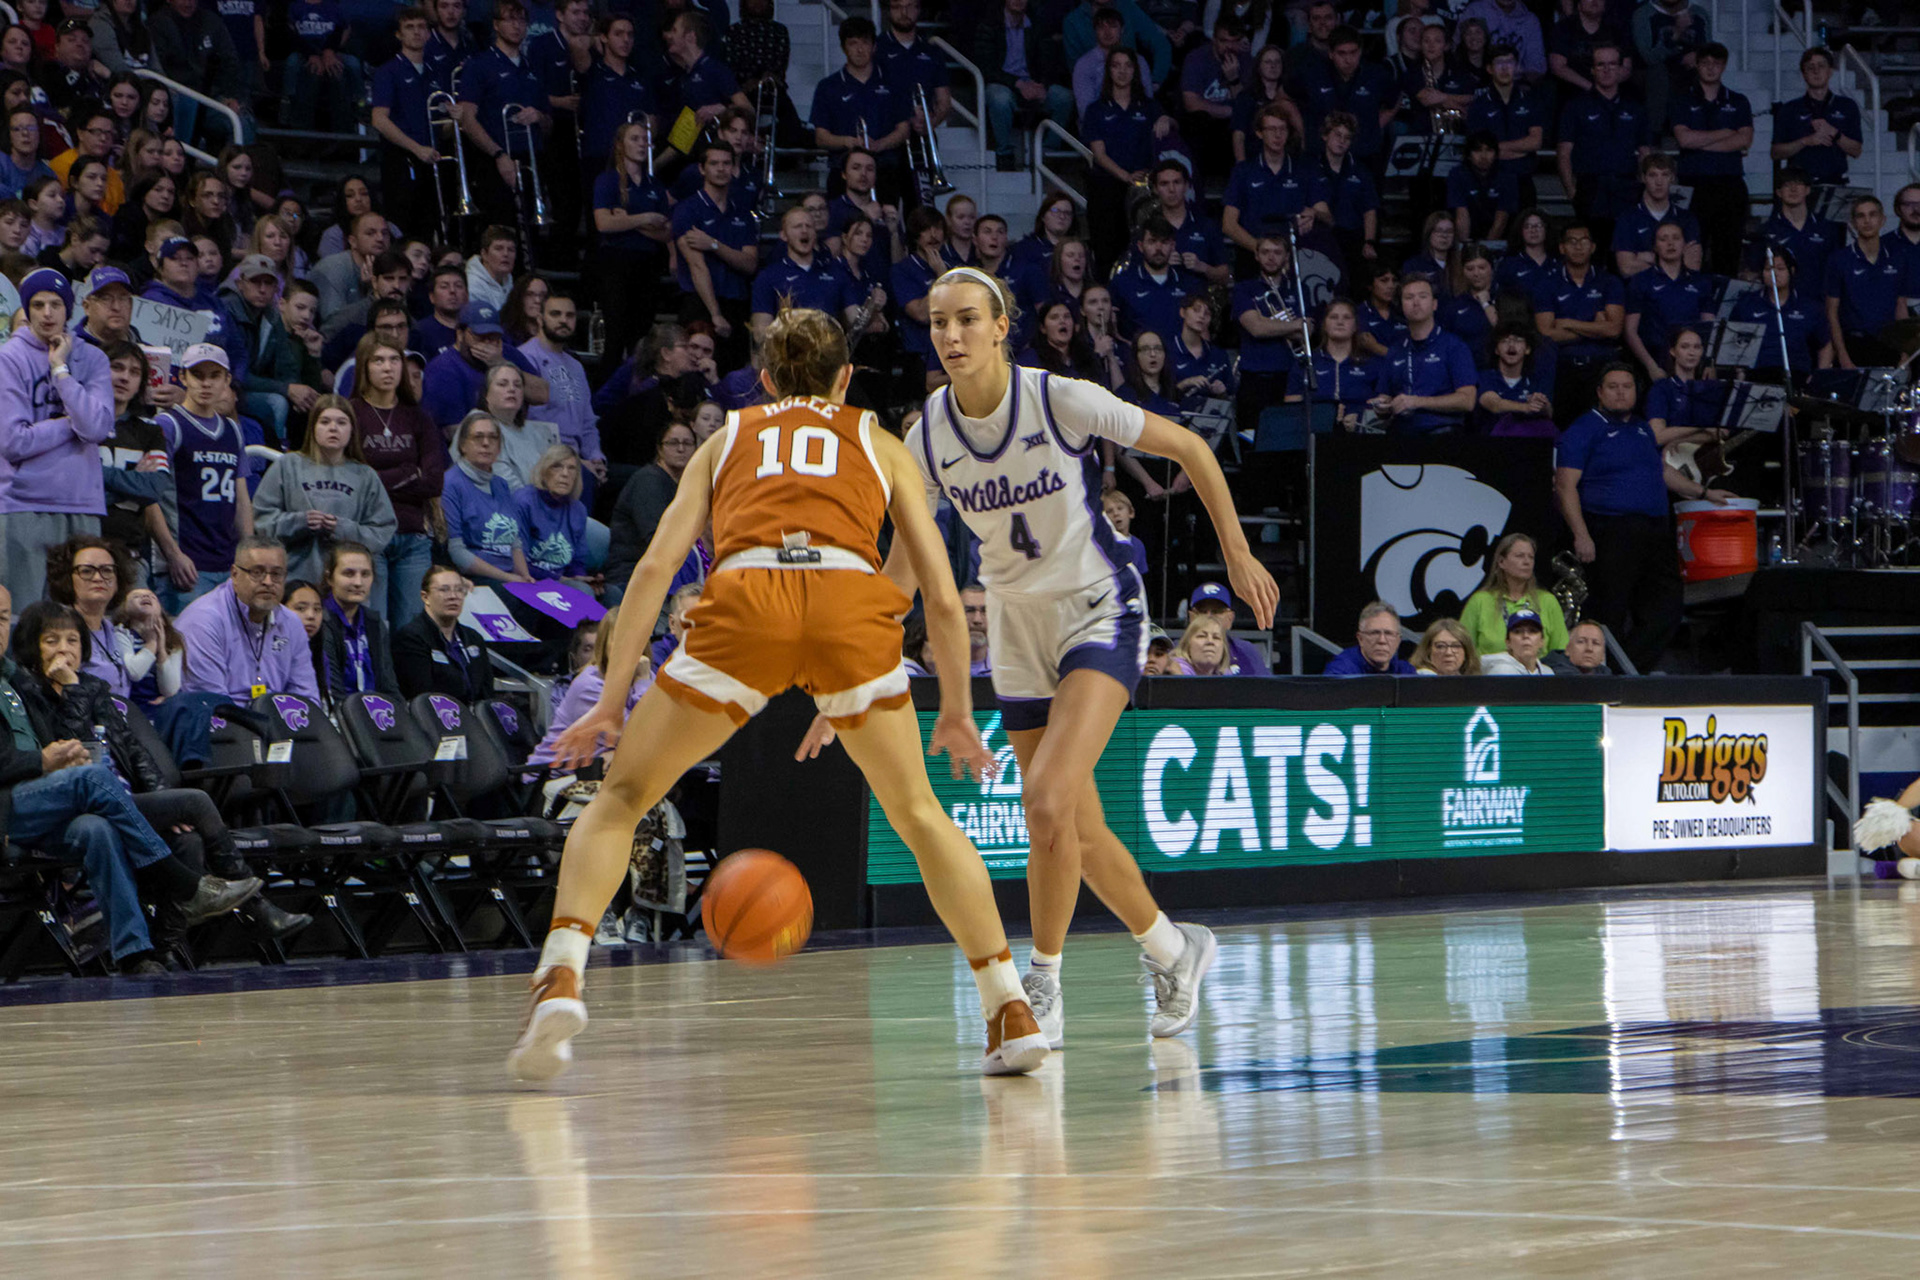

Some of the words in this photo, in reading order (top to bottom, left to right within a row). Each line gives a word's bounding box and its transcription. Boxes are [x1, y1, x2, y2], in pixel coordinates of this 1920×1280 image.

[151, 304, 196, 335] SAYS
[193, 451, 239, 466] K-STATE
[756, 425, 840, 479] 10
[201, 467, 236, 503] 24
[302, 480, 354, 496] K-STATE
[949, 466, 1067, 513] Wildcats
[1010, 512, 1041, 561] 4
[1659, 714, 1768, 804] Briggs
[1142, 723, 1372, 858] CATS!
[1442, 786, 1530, 826] FAIRWAY
[1662, 782, 1709, 801] AUTO.COM
[952, 801, 1030, 845] FAIRW
[1653, 819, 1704, 839] PRE-OWNED
[1706, 816, 1772, 838] HEADQUARTERS
